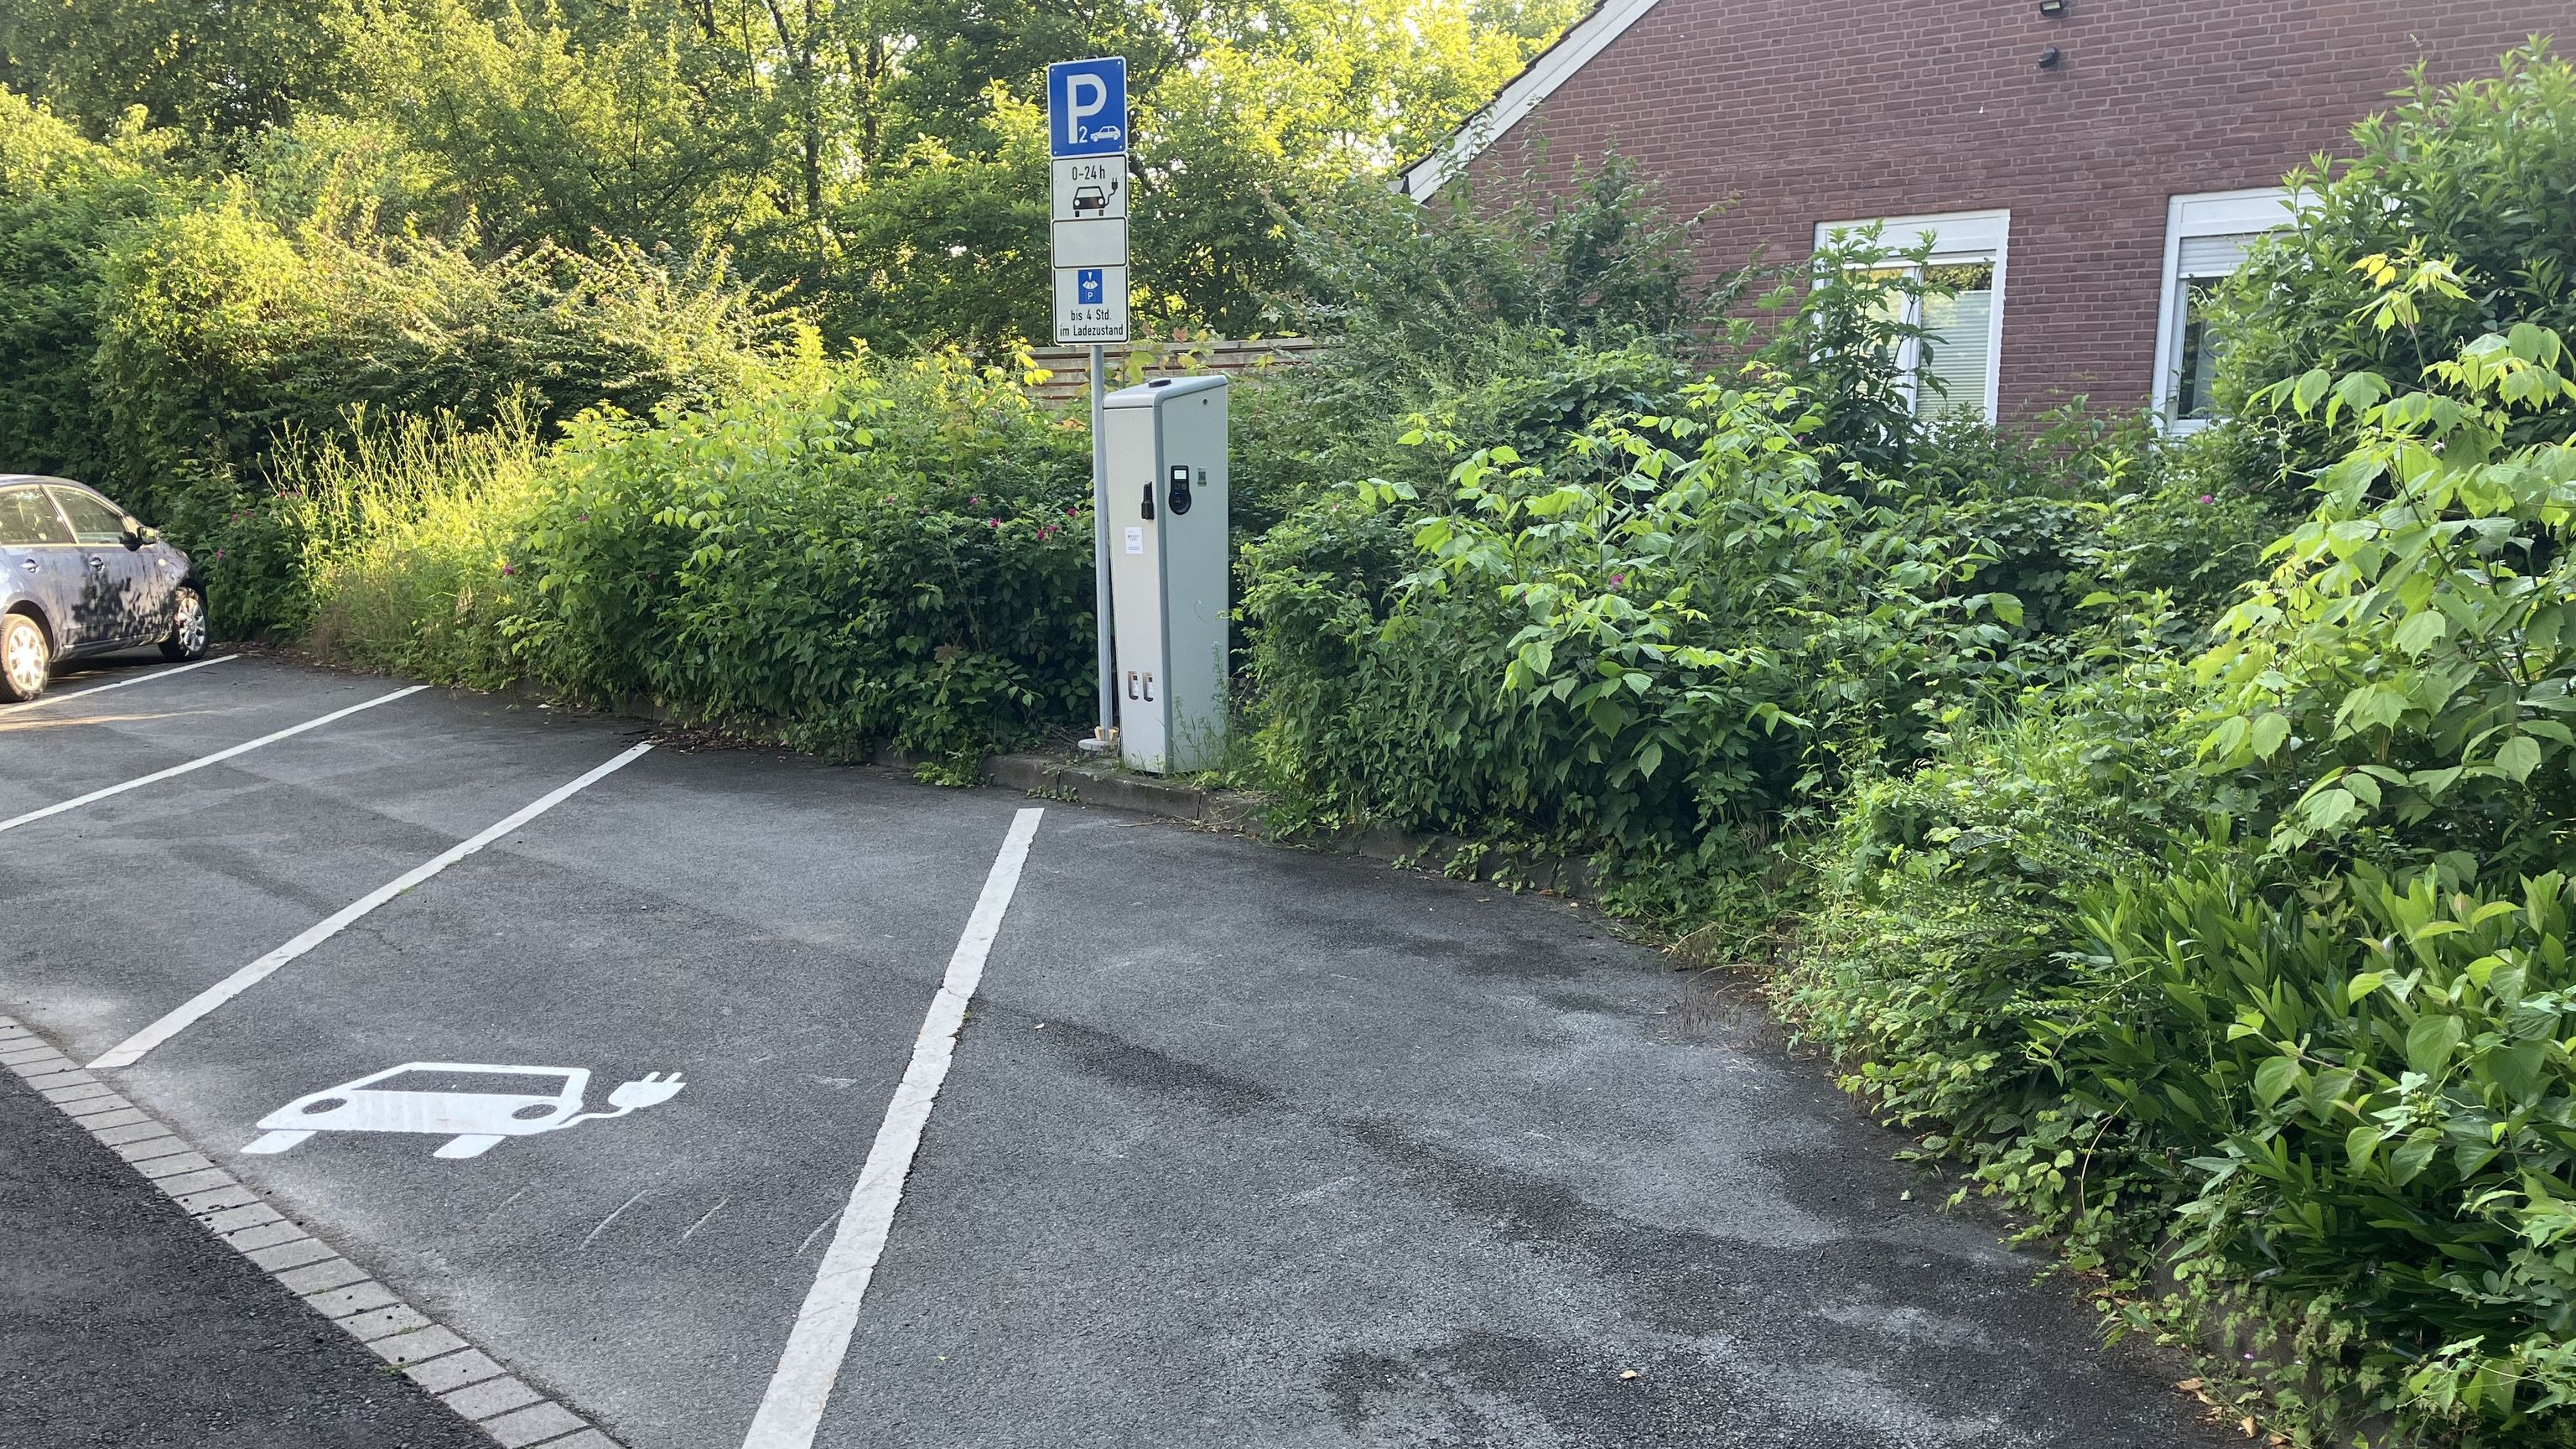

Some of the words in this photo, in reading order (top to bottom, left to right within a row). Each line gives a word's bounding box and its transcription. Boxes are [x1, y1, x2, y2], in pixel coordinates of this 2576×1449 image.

[1067, 73, 1108, 144] P
[1078, 125, 1088, 143] 2
[1099, 164, 1106, 179] h
[1087, 291, 1093, 300] P
[1071, 309, 1083, 321] bis
[1086, 309, 1093, 320] 4
[1095, 309, 1112, 320] Std.
[1059, 325, 1070, 336] im
[1073, 324, 1124, 336] Ladezustand
